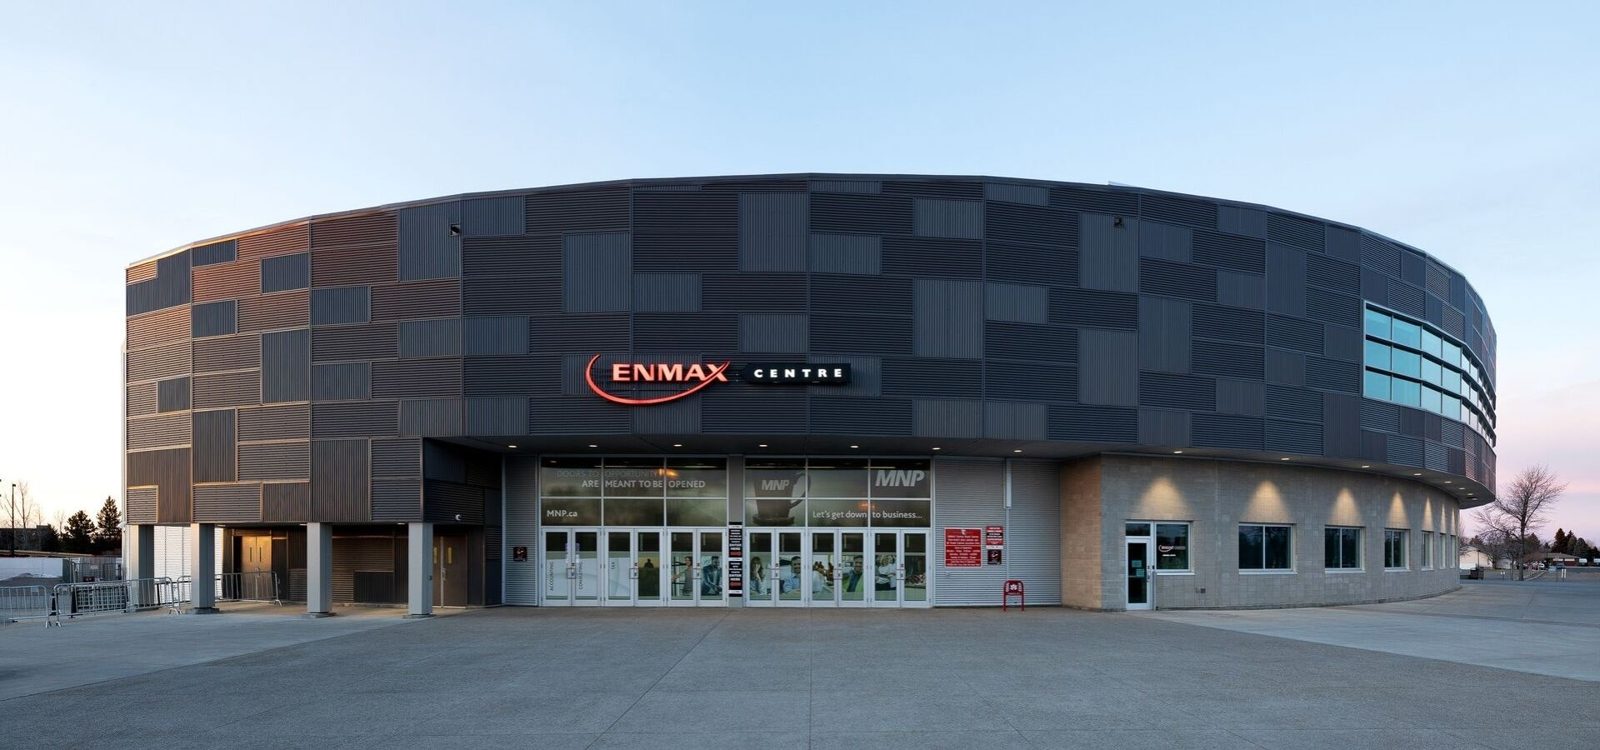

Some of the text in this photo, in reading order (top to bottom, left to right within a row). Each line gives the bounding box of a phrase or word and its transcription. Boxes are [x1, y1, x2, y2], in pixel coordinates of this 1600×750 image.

[612, 362, 843, 382] ENMAX CENTRE
[875, 469, 925, 487] MNP
[582, 480, 705, 488] ARE MEANT TO BE OPENED
[761, 479, 790, 491] MNP
[546, 509, 578, 518] MNP.ca
[812, 510, 923, 521] Let's get down to business...
